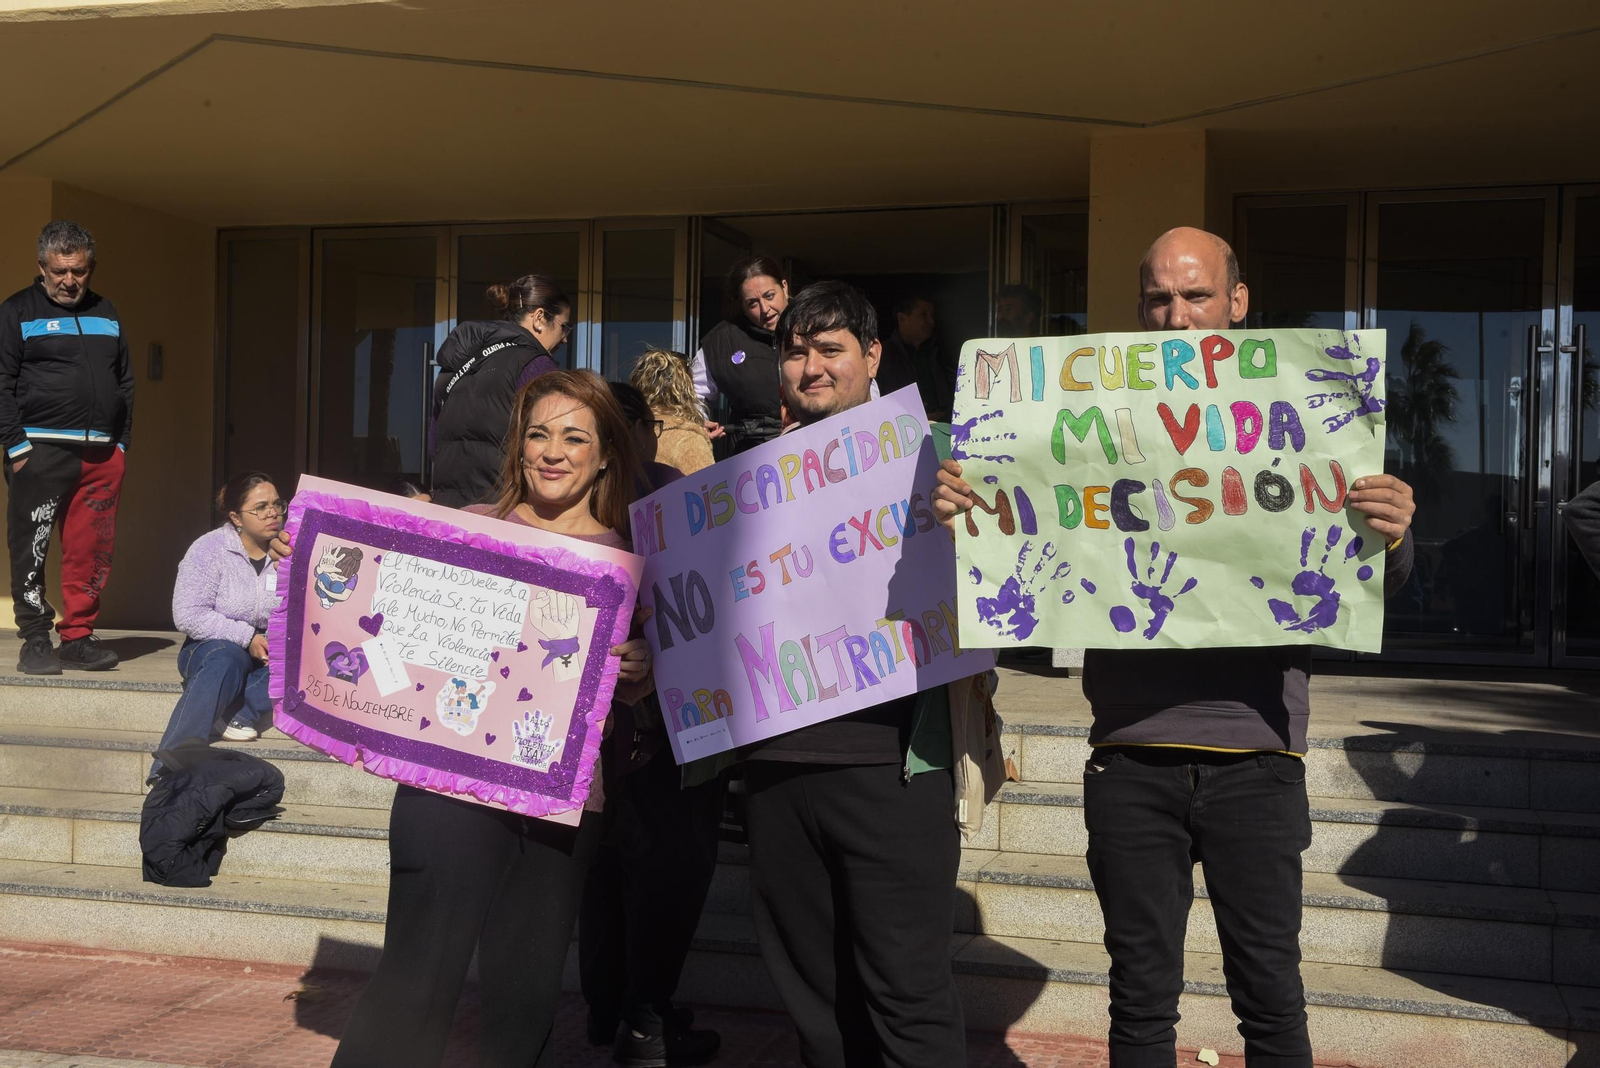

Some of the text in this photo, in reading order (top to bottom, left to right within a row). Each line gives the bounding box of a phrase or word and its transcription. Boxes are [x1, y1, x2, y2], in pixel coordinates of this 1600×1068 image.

[975, 334, 1277, 403] MI CUERPO
[1050, 401, 1306, 465] MI VIDA
[965, 457, 1347, 537] MI DECISIÓN
[383, 551, 528, 601] El Amor No Duele, La
[651, 492, 952, 652] NO ES TU EXCUS
[372, 596, 521, 648] Vale Mucho, No Permitas
[379, 572, 443, 605] Violencia
[470, 597, 489, 614] Tu
[492, 602, 522, 624] Vida
[382, 619, 491, 663] Que La Violencia
[424, 650, 488, 679] Silencie
[306, 674, 323, 697] 25
[514, 736, 555, 754] VIOLENCIA
[530, 716, 549, 727] Alto
[520, 746, 543, 760] ¡YA!
